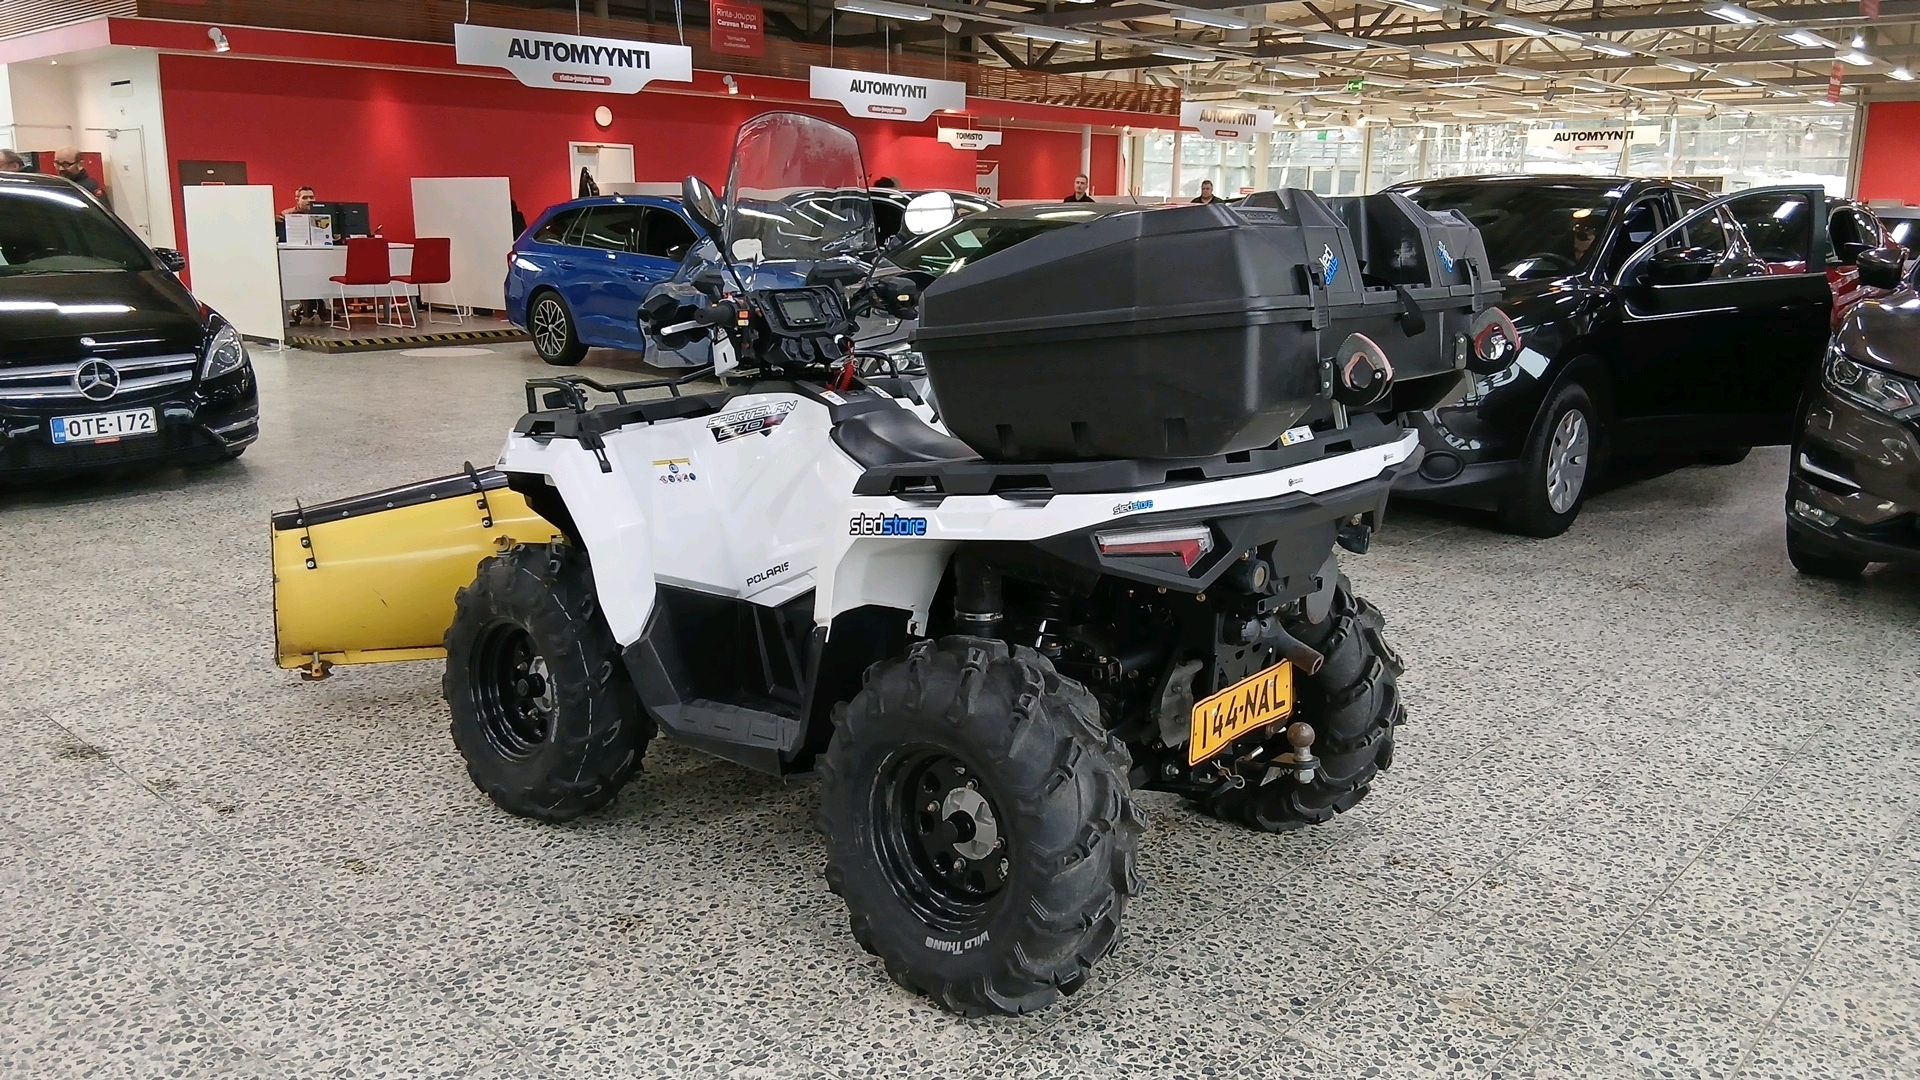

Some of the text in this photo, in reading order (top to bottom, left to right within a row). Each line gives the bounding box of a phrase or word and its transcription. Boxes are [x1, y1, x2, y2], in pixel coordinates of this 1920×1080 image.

[716, 8, 757, 21] Rinta-Jouppi
[717, 19, 757, 30] Caravan Turva
[508, 38, 650, 69] AUTOMYYNTI
[850, 79, 927, 99] AUTOMYYNTI
[1199, 109, 1256, 126] AUTOMYYNTI
[956, 132, 983, 141] TOIMISTO
[1553, 130, 1635, 142] AUTOMYYNTI
[706, 400, 798, 428] SPORTSMAN
[69, 412, 151, 437] OTE-172
[718, 419, 765, 439] 570
[1113, 500, 1153, 515] sledstore
[849, 513, 927, 536] sledstore
[746, 561, 789, 587] POLARIS
[1202, 674, 1286, 749] 144-NAL
[964, 930, 990, 950] WILD
